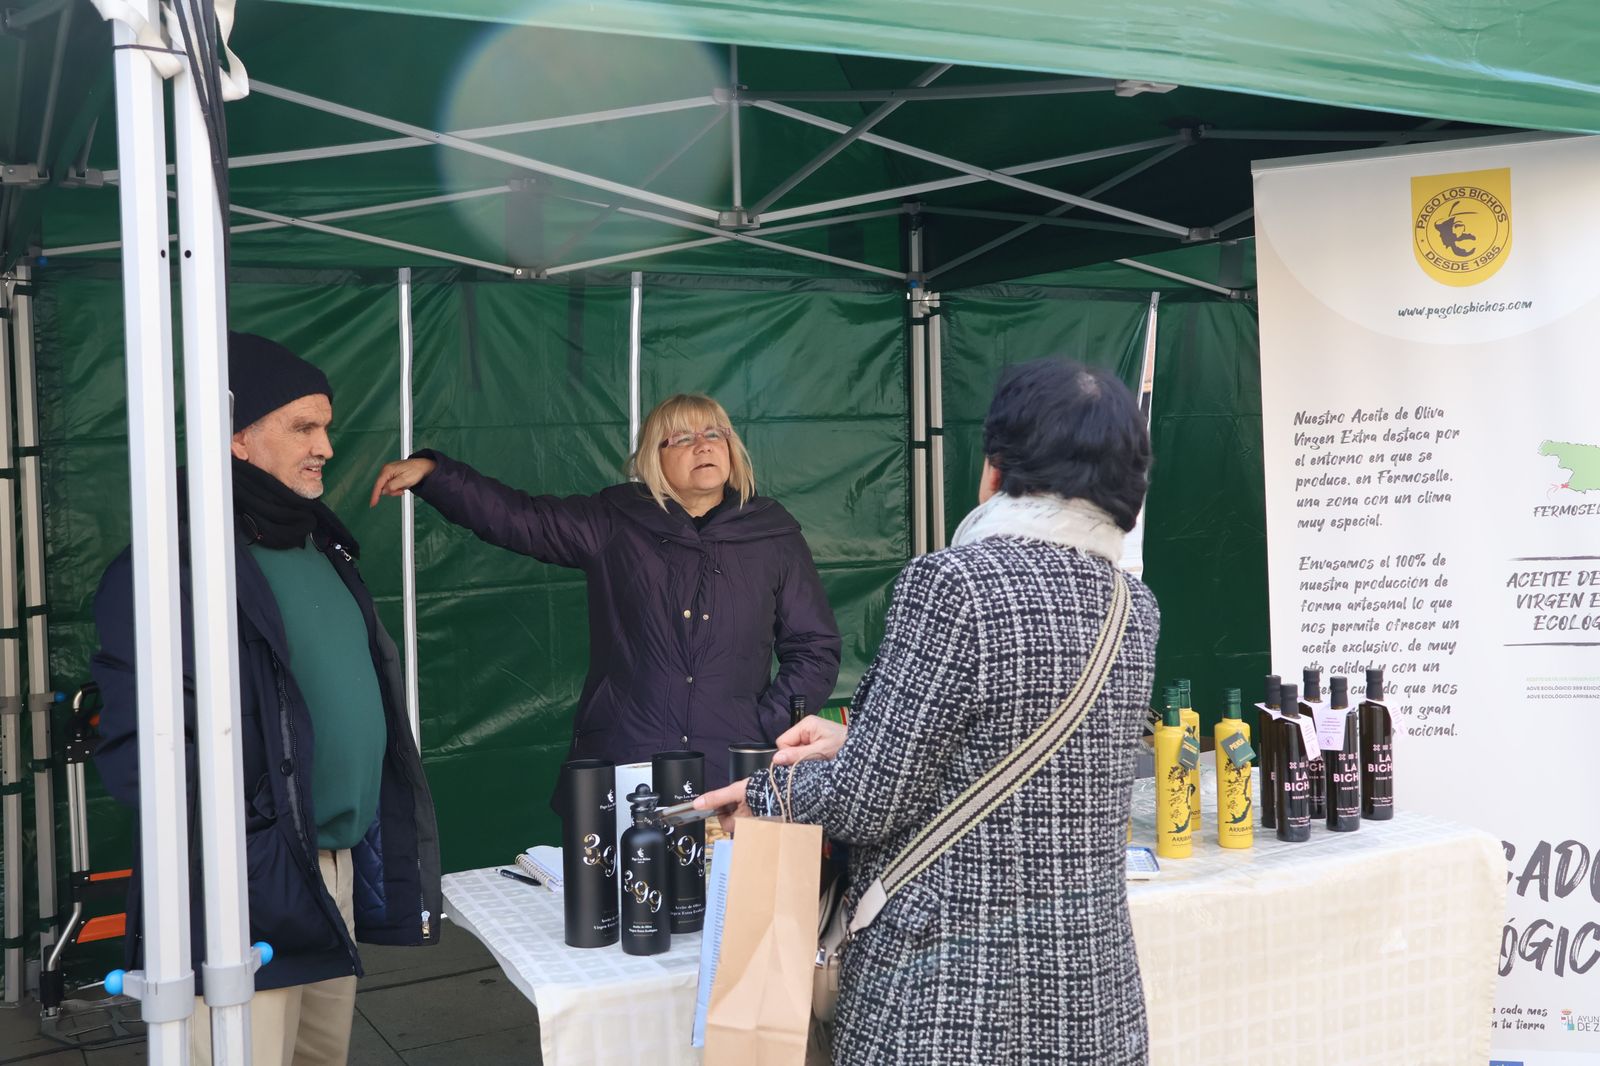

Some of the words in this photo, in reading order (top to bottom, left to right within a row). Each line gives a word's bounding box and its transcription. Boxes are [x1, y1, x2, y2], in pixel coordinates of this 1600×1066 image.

[1416, 198, 1441, 230] PAGO
[1442, 188, 1466, 201] LOS
[1469, 188, 1507, 223] BICHOS
[1425, 250, 1470, 271] DESDE
[1474, 245, 1501, 267] 1985
[1398, 300, 1532, 319] www.pagolosbichos.com
[1294, 410, 1345, 426] Nuestro
[1351, 408, 1389, 423] Aceite
[1394, 406, 1409, 420] de
[1414, 405, 1445, 420] Oliva
[1294, 431, 1335, 450] Virgen
[1340, 430, 1377, 445] Extra
[1383, 427, 1430, 443] destaca
[1435, 428, 1461, 444] por
[1295, 454, 1305, 467] el
[1310, 452, 1364, 466] entorno
[1369, 453, 1385, 463] en
[1390, 452, 1413, 467] que
[1418, 451, 1433, 463] se
[1356, 474, 1372, 485] en
[1296, 498, 1320, 508] una
[1326, 496, 1359, 507] zona
[1364, 494, 1389, 506] con
[1394, 494, 1412, 504] un
[1418, 490, 1452, 504] clima
[1297, 518, 1326, 532] muy
[1330, 514, 1383, 532] especial.
[1298, 556, 1375, 571] Envasamos
[1380, 556, 1390, 568] el
[1396, 554, 1427, 568] 100%
[1432, 552, 1447, 566] de
[1300, 576, 1349, 592] nuestra
[1434, 574, 1449, 587] de
[1506, 570, 1572, 589] ACEITE
[1577, 570, 1600, 587] DE
[1301, 600, 1342, 613] forma
[1348, 597, 1407, 612] artesanal
[1412, 597, 1424, 610] lo
[1430, 599, 1453, 614] que
[1516, 592, 1585, 611] VIRGEN
[1301, 622, 1326, 634] nos
[1331, 618, 1380, 637] permite
[1386, 618, 1436, 631] ofrecer
[1442, 619, 1460, 630] un
[1302, 640, 1336, 654] aceite
[1408, 638, 1422, 652] de
[1428, 641, 1457, 655] muy
[1330, 660, 1373, 674] calidad
[1392, 662, 1417, 673] con
[1423, 662, 1440, 673] un
[1404, 684, 1426, 699] que
[1432, 684, 1458, 695] nos
[1418, 704, 1451, 720] gran
[1379, 754, 1392, 763] LA
[1296, 772, 1308, 781] LA
[1344, 763, 1357, 773] LA
[1501, 840, 1600, 903] AD
[624, 870, 662, 913] 399
[1500, 1004, 1523, 1015] cada
[1526, 1008, 1548, 1017] mes
[1502, 1018, 1512, 1030] tu
[1516, 1019, 1545, 1031] tierra
[1578, 1022, 1591, 1032] DE
